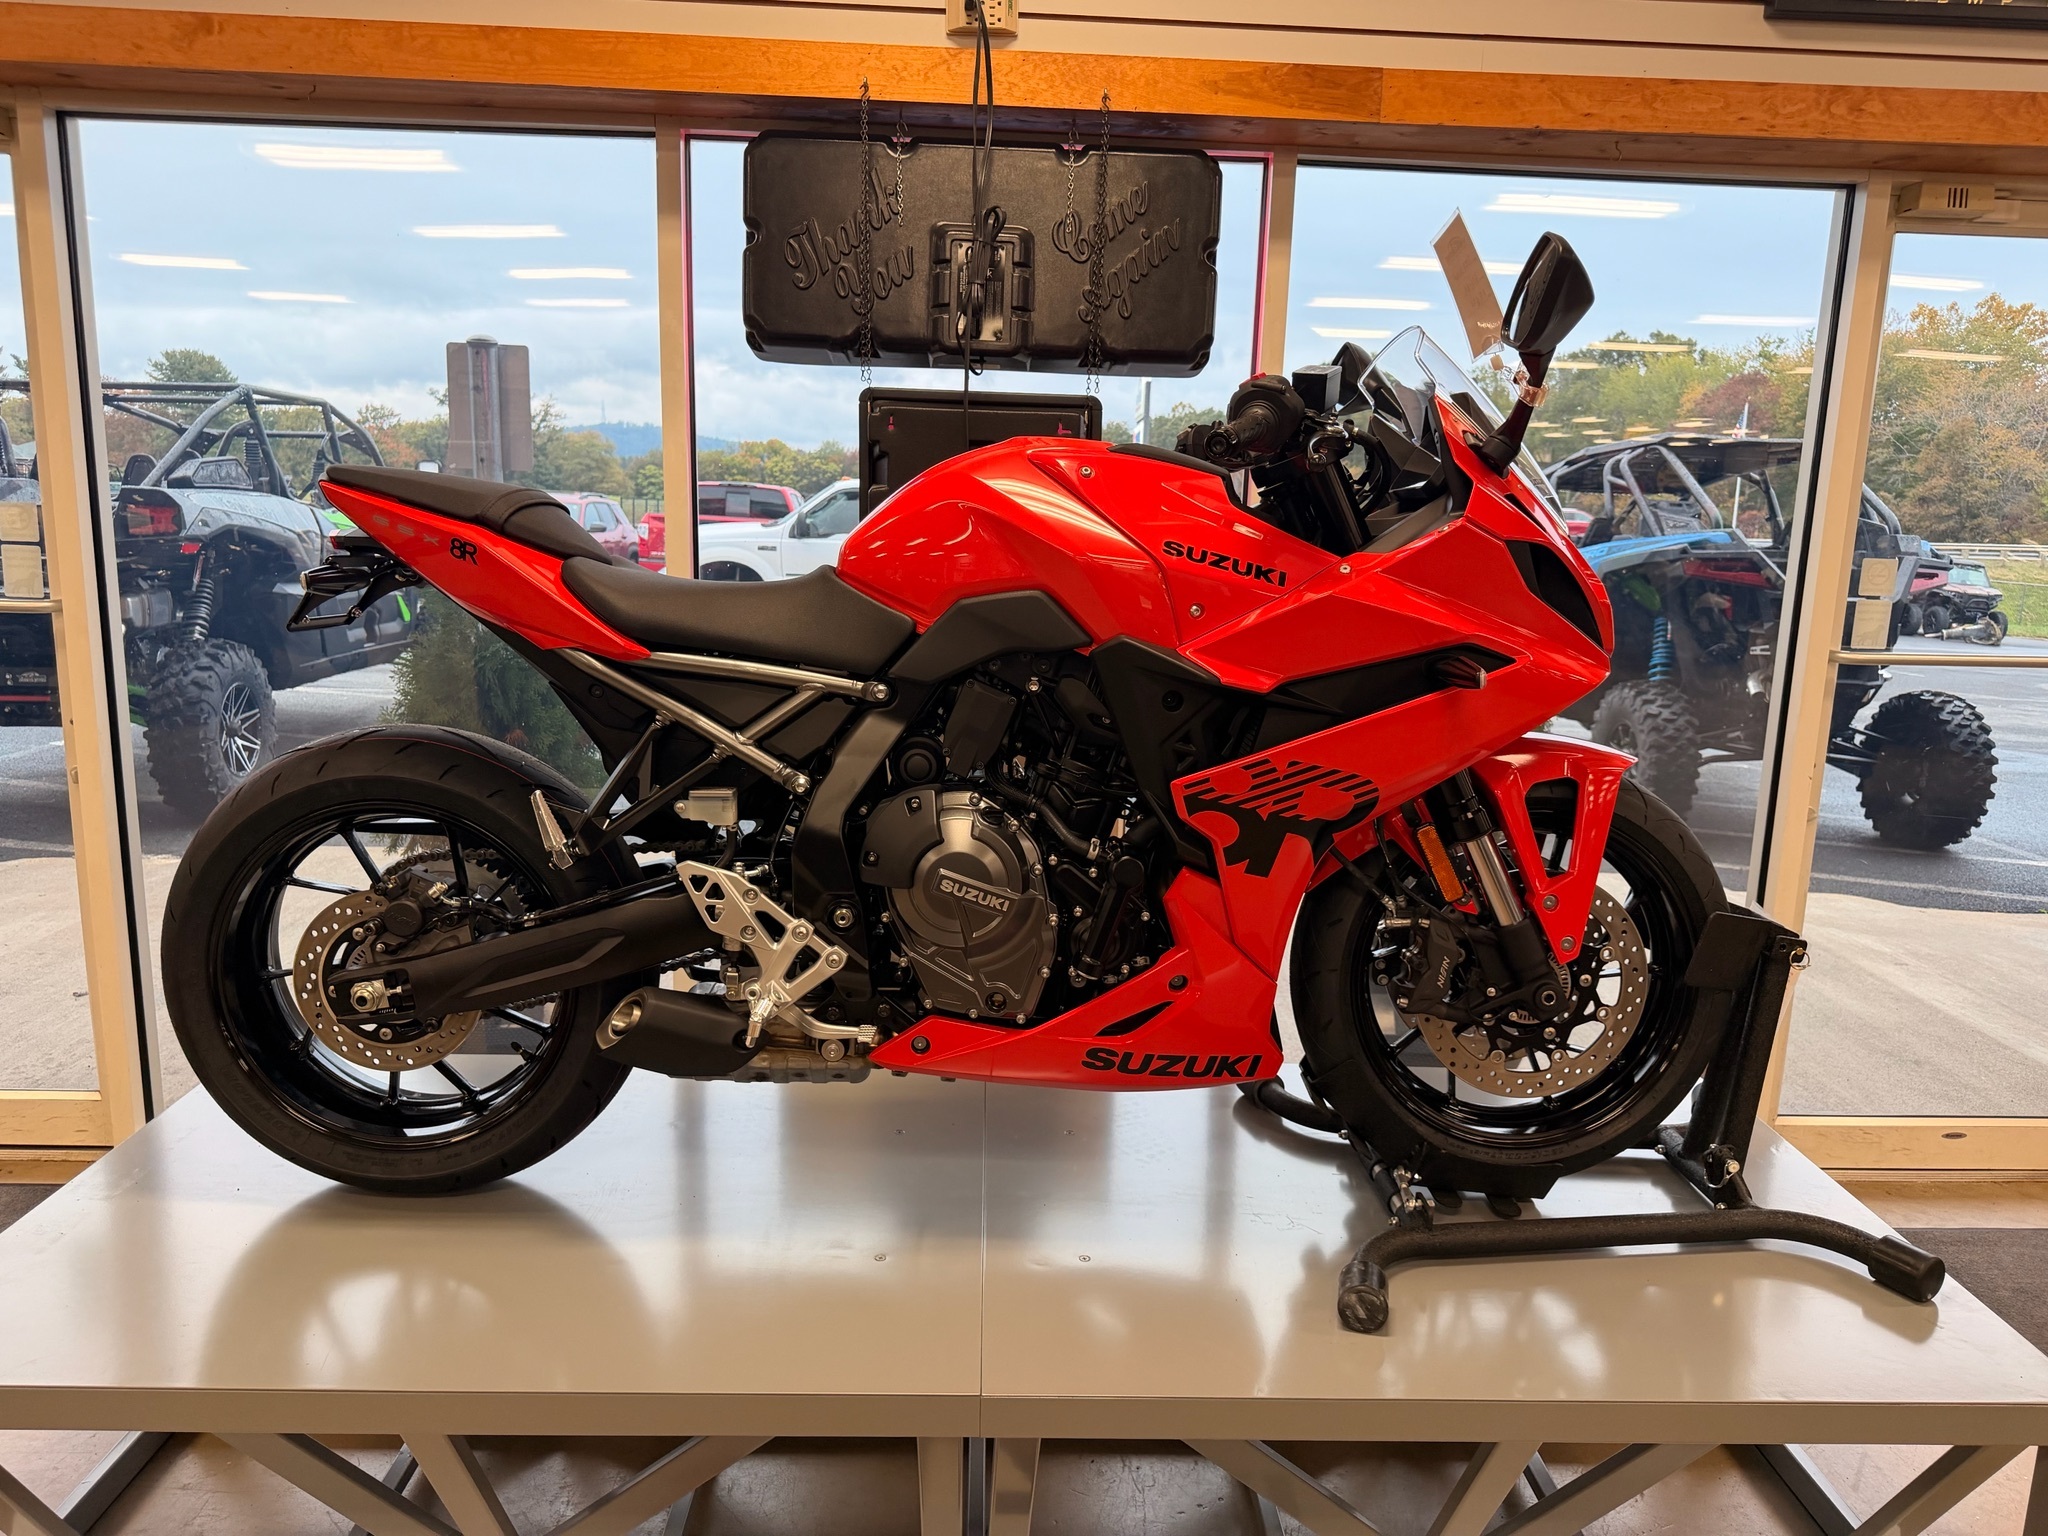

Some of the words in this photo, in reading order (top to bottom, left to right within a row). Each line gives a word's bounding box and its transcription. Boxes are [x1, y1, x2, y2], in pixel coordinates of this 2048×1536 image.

[784, 167, 902, 290] Thank
[1051, 181, 1149, 264] Come
[834, 245, 914, 316] You
[1077, 217, 1180, 323] Again
[449, 537, 478, 566] 8R
[1161, 540, 1287, 588] SUZUKI
[939, 879, 1010, 912] SUZUKI
[1081, 1046, 1263, 1078] SUZUKI
